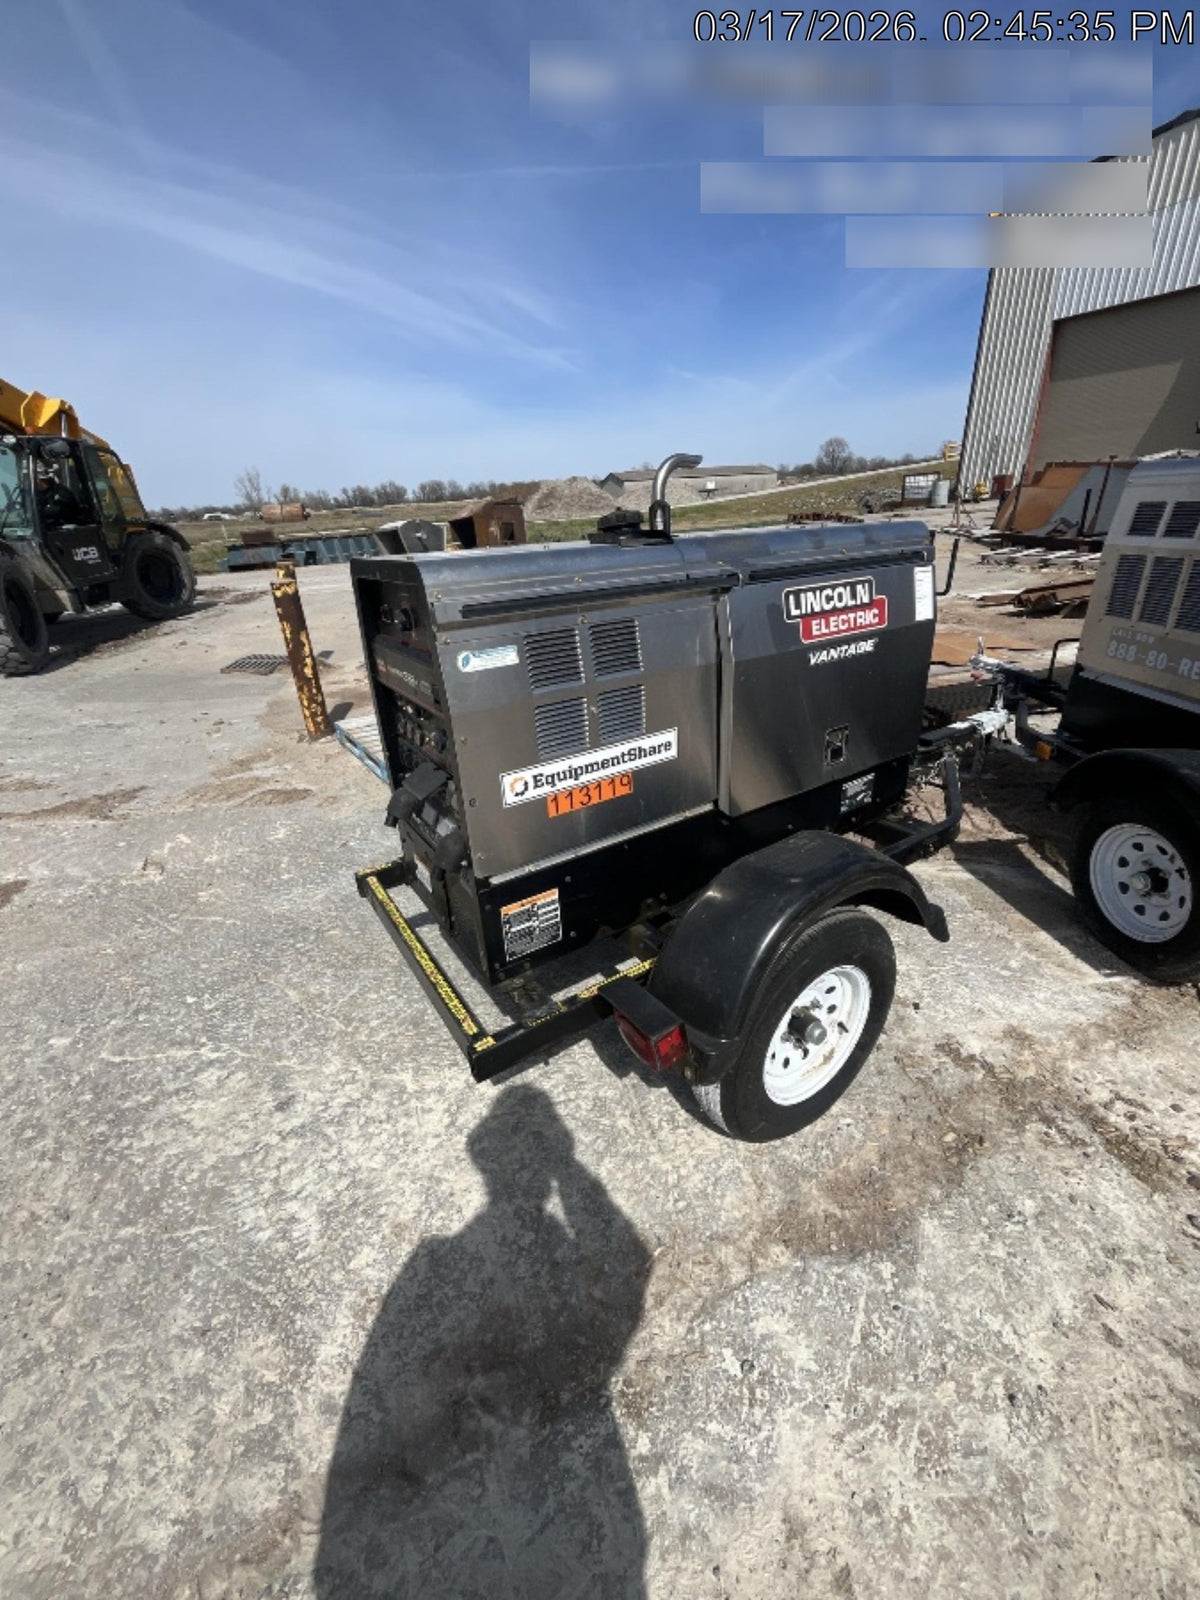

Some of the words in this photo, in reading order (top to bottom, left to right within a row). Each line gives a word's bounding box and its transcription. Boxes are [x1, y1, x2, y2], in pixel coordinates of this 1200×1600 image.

[72, 546, 99, 561] JCB
[788, 582, 870, 616] LINCOLN
[811, 608, 880, 636] ELECTRIC
[808, 639, 875, 666] VANTAGE
[532, 739, 673, 790] EquipmentShare
[550, 773, 632, 814] 113119
